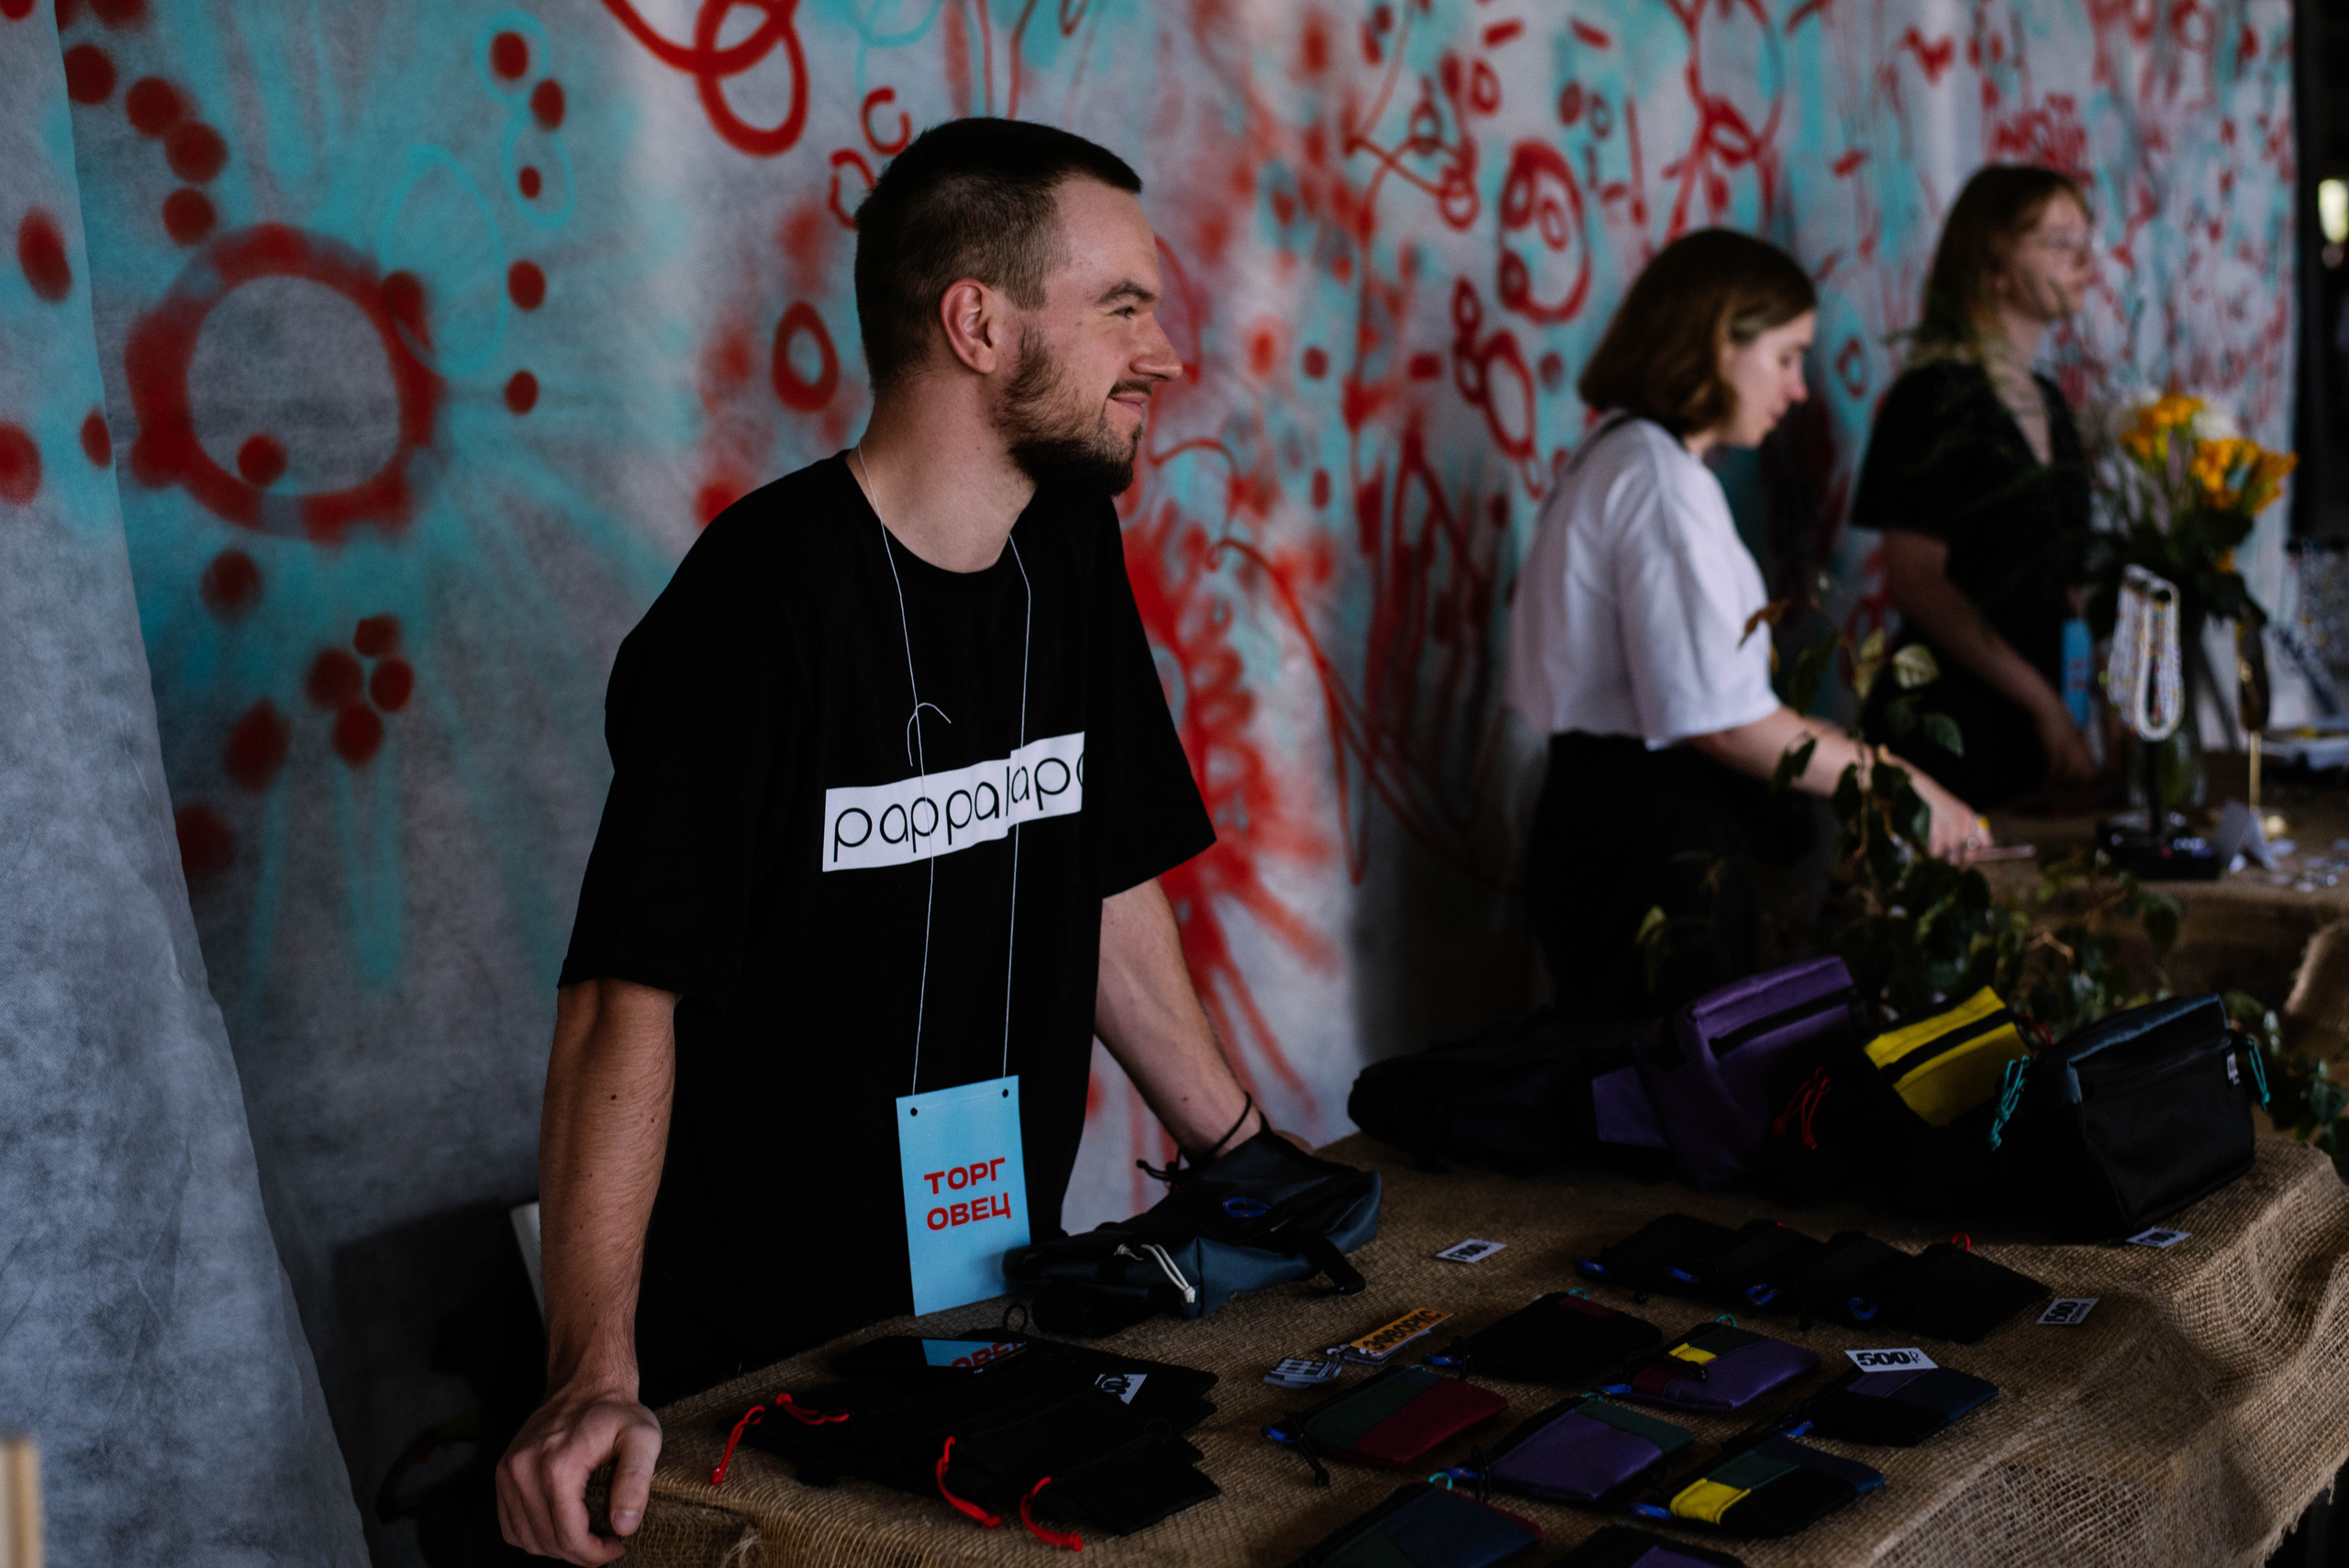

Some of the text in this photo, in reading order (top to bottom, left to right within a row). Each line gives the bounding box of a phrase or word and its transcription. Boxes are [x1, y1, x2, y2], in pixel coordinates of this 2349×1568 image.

[832, 753, 1084, 863] pappalap
[923, 1157, 1006, 1195] ТОРГ
[926, 1192, 1011, 1231] ОВЕЦ
